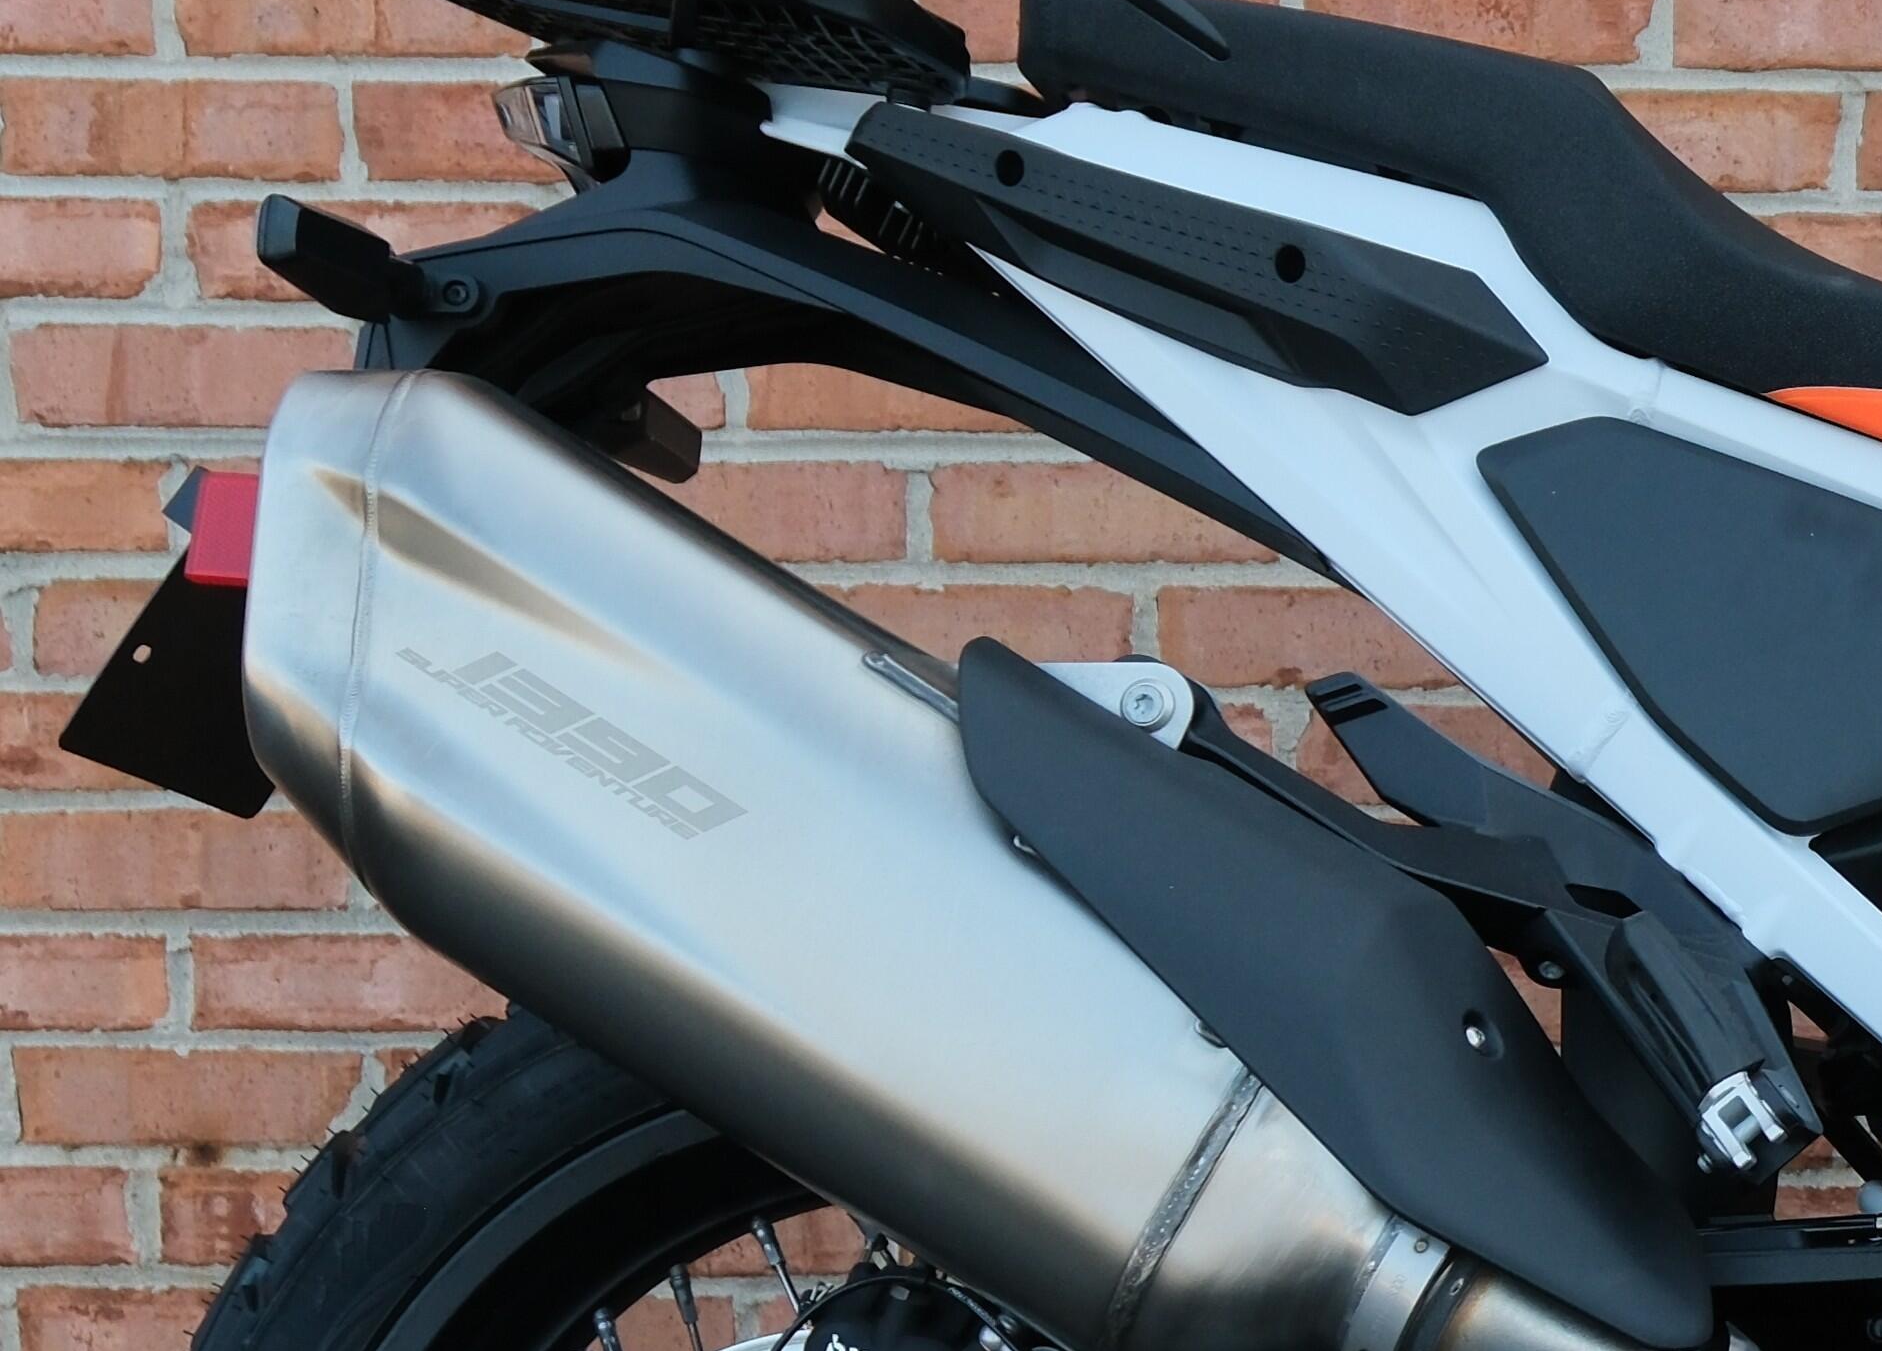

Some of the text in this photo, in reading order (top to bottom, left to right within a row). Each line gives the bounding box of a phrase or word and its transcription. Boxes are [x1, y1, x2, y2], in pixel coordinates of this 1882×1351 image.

[395, 647, 700, 841] SUPER ADVENTURE
[452, 651, 749, 833] 1390
